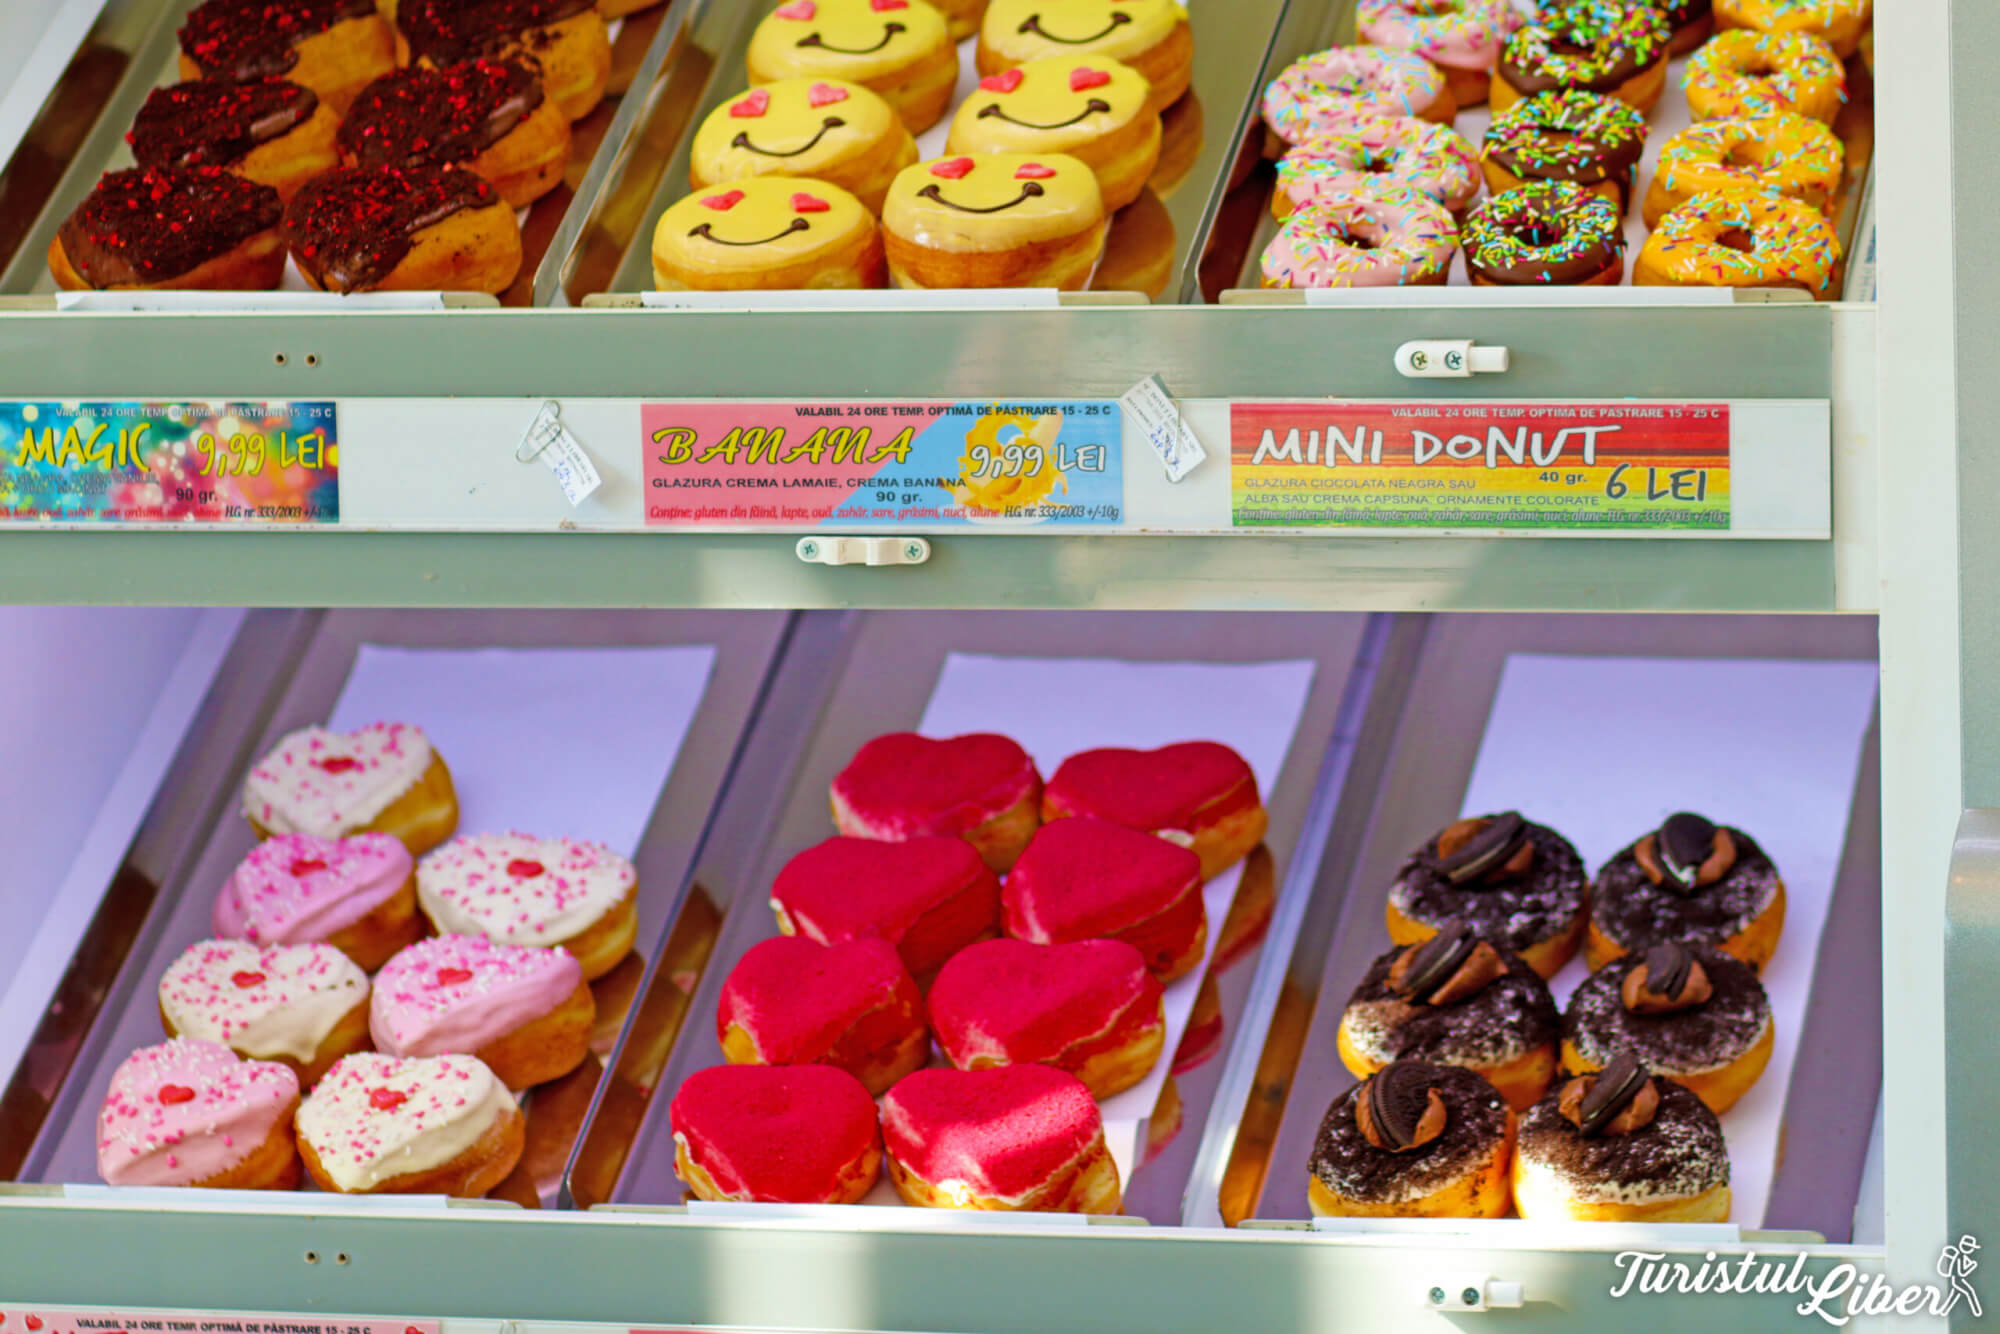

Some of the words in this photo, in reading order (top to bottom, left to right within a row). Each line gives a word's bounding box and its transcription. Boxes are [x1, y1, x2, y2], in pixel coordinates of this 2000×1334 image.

[56, 406, 97, 417] VALABIL
[101, 406, 112, 417] 24
[116, 406, 136, 417] ORE
[310, 406, 321, 417] 25
[324, 406, 331, 417] C
[795, 407, 843, 416] VALABIL
[847, 407, 861, 416] 24
[864, 407, 888, 416] ORE
[893, 407, 924, 416] TEMP.
[976, 407, 991, 416] DE
[1062, 407, 1074, 416] 15
[1085, 407, 1099, 416] 25
[1102, 407, 1111, 416] C
[1392, 408, 1441, 417] VALABIL
[1445, 408, 1459, 417] 24
[1463, 408, 1488, 417] ORE
[1492, 408, 1524, 417] TEMP.
[1580, 408, 1595, 418] DE
[1669, 408, 1682, 418] 15
[1693, 408, 1707, 418] 25
[1711, 408, 1720, 418] C
[18, 423, 151, 472] MAGIC
[652, 426, 915, 465] BANANA
[1251, 424, 1383, 468] MINI
[1411, 424, 1622, 468] DONUT
[198, 433, 265, 477] 9,99
[280, 431, 324, 469] LEI
[970, 445, 1044, 478] 9,99
[1059, 443, 1105, 472] LEI
[652, 478, 722, 488] GLAZURA
[726, 478, 778, 488] CREMA
[783, 478, 842, 489] LAMAIE,
[847, 478, 899, 488] CREMA
[903, 478, 966, 488] BANANA
[1245, 478, 1306, 489] GLAZURA
[1311, 478, 1385, 489] CIOCOLATA
[1389, 478, 1445, 489] NEAGRA
[1448, 478, 1476, 489] SAU
[1539, 472, 1559, 482] 40
[1566, 473, 1588, 485] gr.
[1606, 463, 1630, 500] 6
[1647, 467, 1706, 501] LEI
[175, 488, 193, 501] 90
[199, 490, 217, 504] gr.
[876, 492, 895, 502] 90
[901, 493, 922, 504] gr.
[1244, 494, 1278, 505] ALBA
[1282, 494, 1308, 505] SAU
[1312, 494, 1361, 505] CREMA
[1436, 494, 1522, 505] ORNAMENTE
[1526, 494, 1600, 505] COLORATE
[257, 505, 302, 519] 333/2003
[694, 505, 728, 521] gluten
[730, 505, 747, 519] din
[1025, 507, 1036, 518] nr.
[1039, 505, 1085, 520] 333/2003
[1087, 505, 1119, 520] +/-10g
[1285, 508, 1319, 522] gluten
[1322, 507, 1339, 521] din
[1643, 509, 1691, 524] 333/2003
[1693, 509, 1727, 524] +/-10g
[76, 1319, 121, 1329] VALABIL
[125, 1320, 137, 1329] 24
[141, 1320, 163, 1330] ORE
[167, 1321, 197, 1331] TEMP.
[246, 1323, 260, 1333] DE
[325, 1326, 338, 1334] 15
